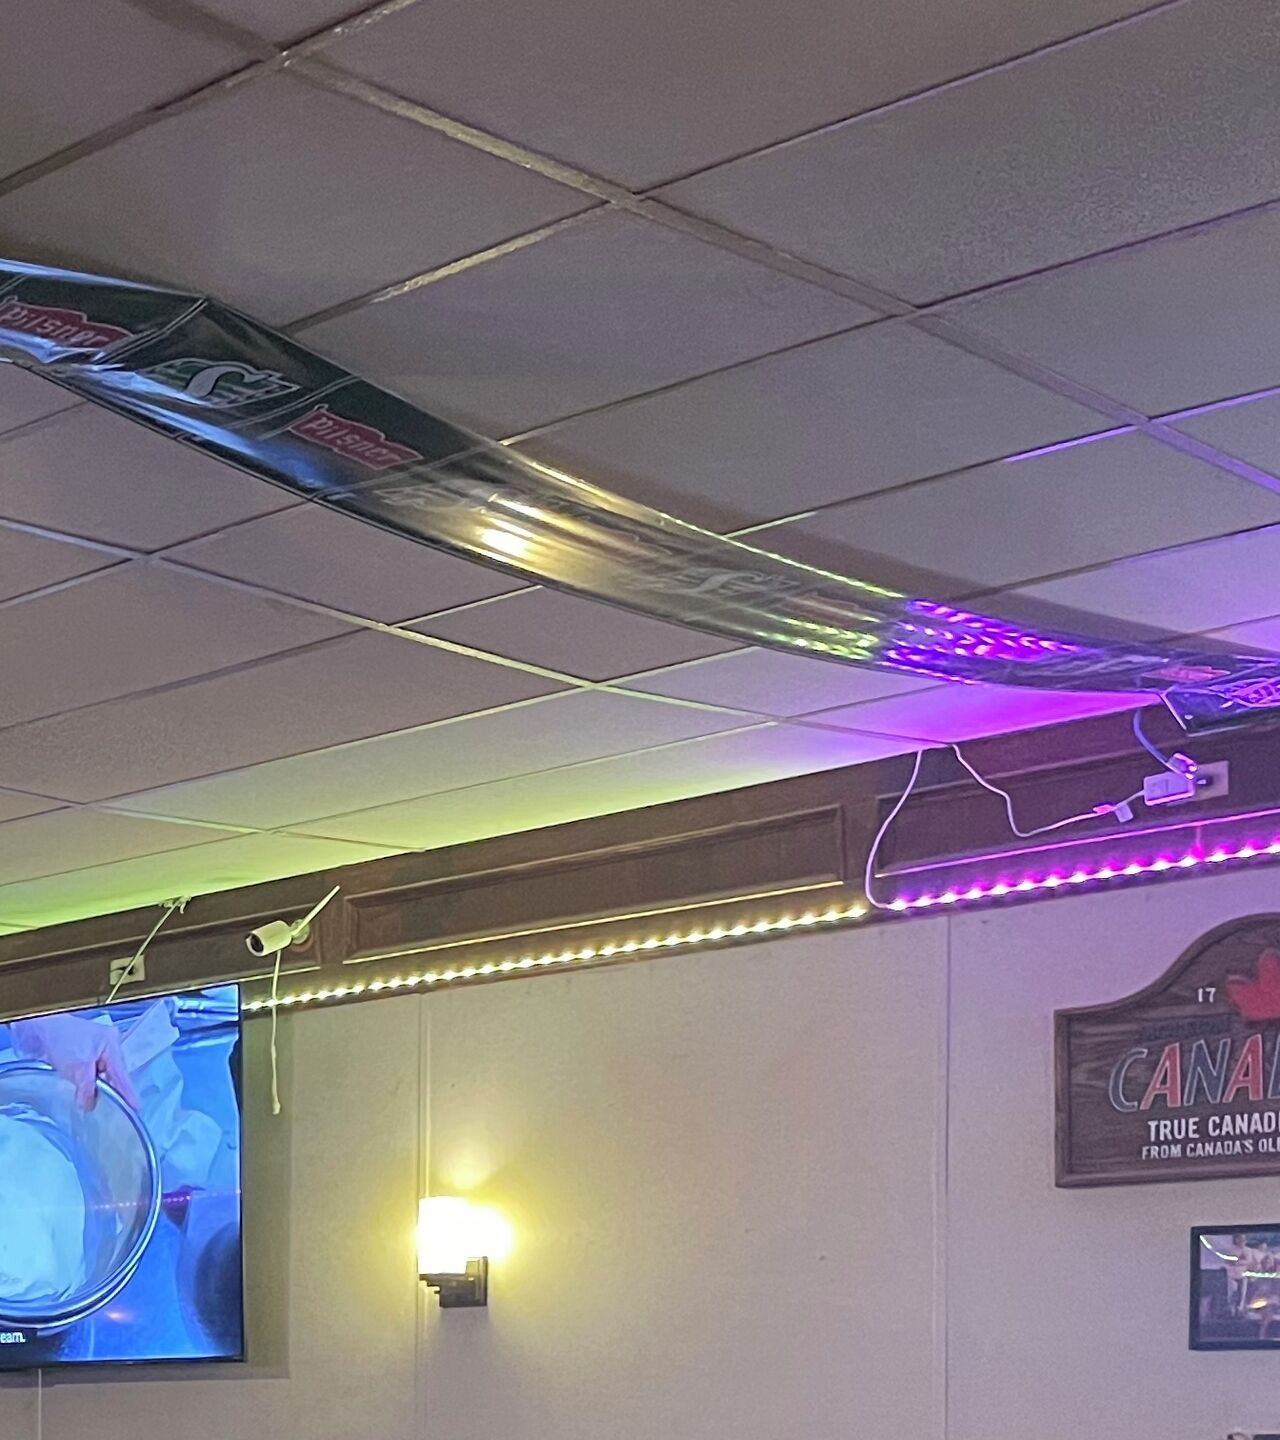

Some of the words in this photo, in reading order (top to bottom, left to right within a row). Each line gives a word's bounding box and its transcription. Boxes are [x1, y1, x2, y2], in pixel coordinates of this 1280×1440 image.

[303, 416, 402, 464] Pilsner
[1108, 1033, 1280, 1113] CANA
[1147, 1117, 1200, 1142] TRUE
[1208, 1110, 1280, 1137] CANAD
[1142, 1143, 1182, 1160] FROM
[1186, 1139, 1254, 1158] CANADA'S
